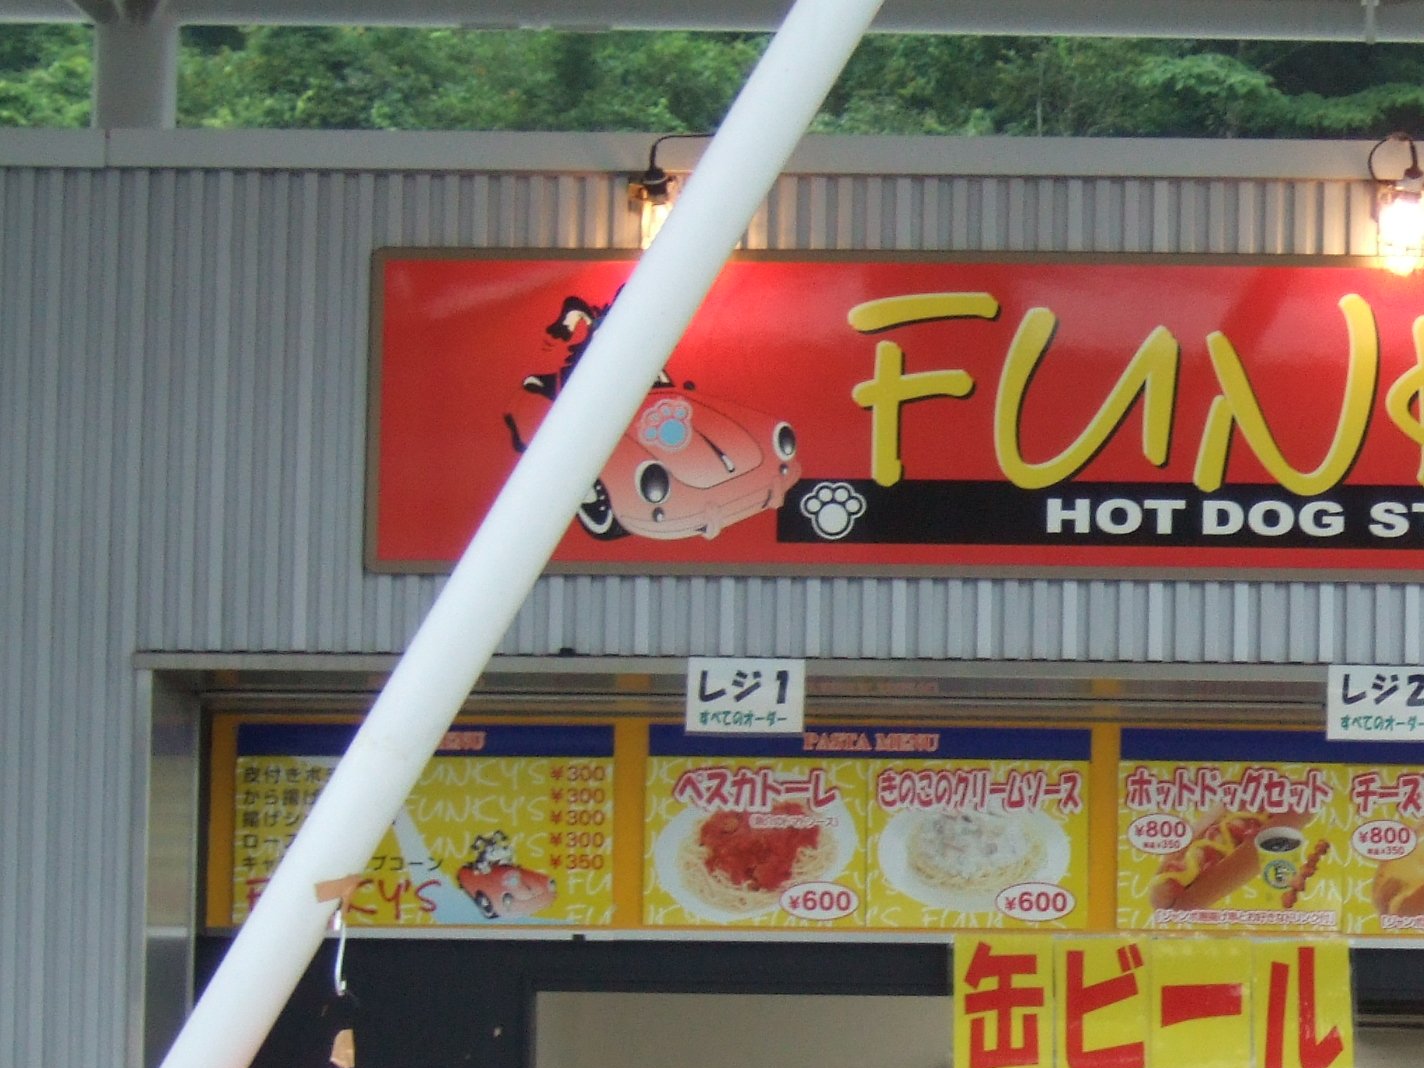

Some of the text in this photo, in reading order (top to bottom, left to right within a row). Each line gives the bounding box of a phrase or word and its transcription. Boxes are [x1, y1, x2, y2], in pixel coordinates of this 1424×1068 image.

[1045, 497, 1188, 537] HOT
[1201, 499, 1346, 541] DOG
[698, 669, 789, 704] レジ1
[699, 710, 787, 727] すべてのオーダー
[551, 766, 605, 781] ¥300
[551, 788, 605, 803] ¥300
[1125, 767, 1334, 814] ホットドッグセット
[551, 810, 605, 825] ¥300
[1135, 820, 1187, 838] ¥800
[1359, 827, 1410, 844] ¥800
[551, 832, 605, 848] ¥300
[551, 854, 605, 869] ¥350
[788, 890, 852, 912] ¥600
[1005, 891, 1068, 913] ¥600
